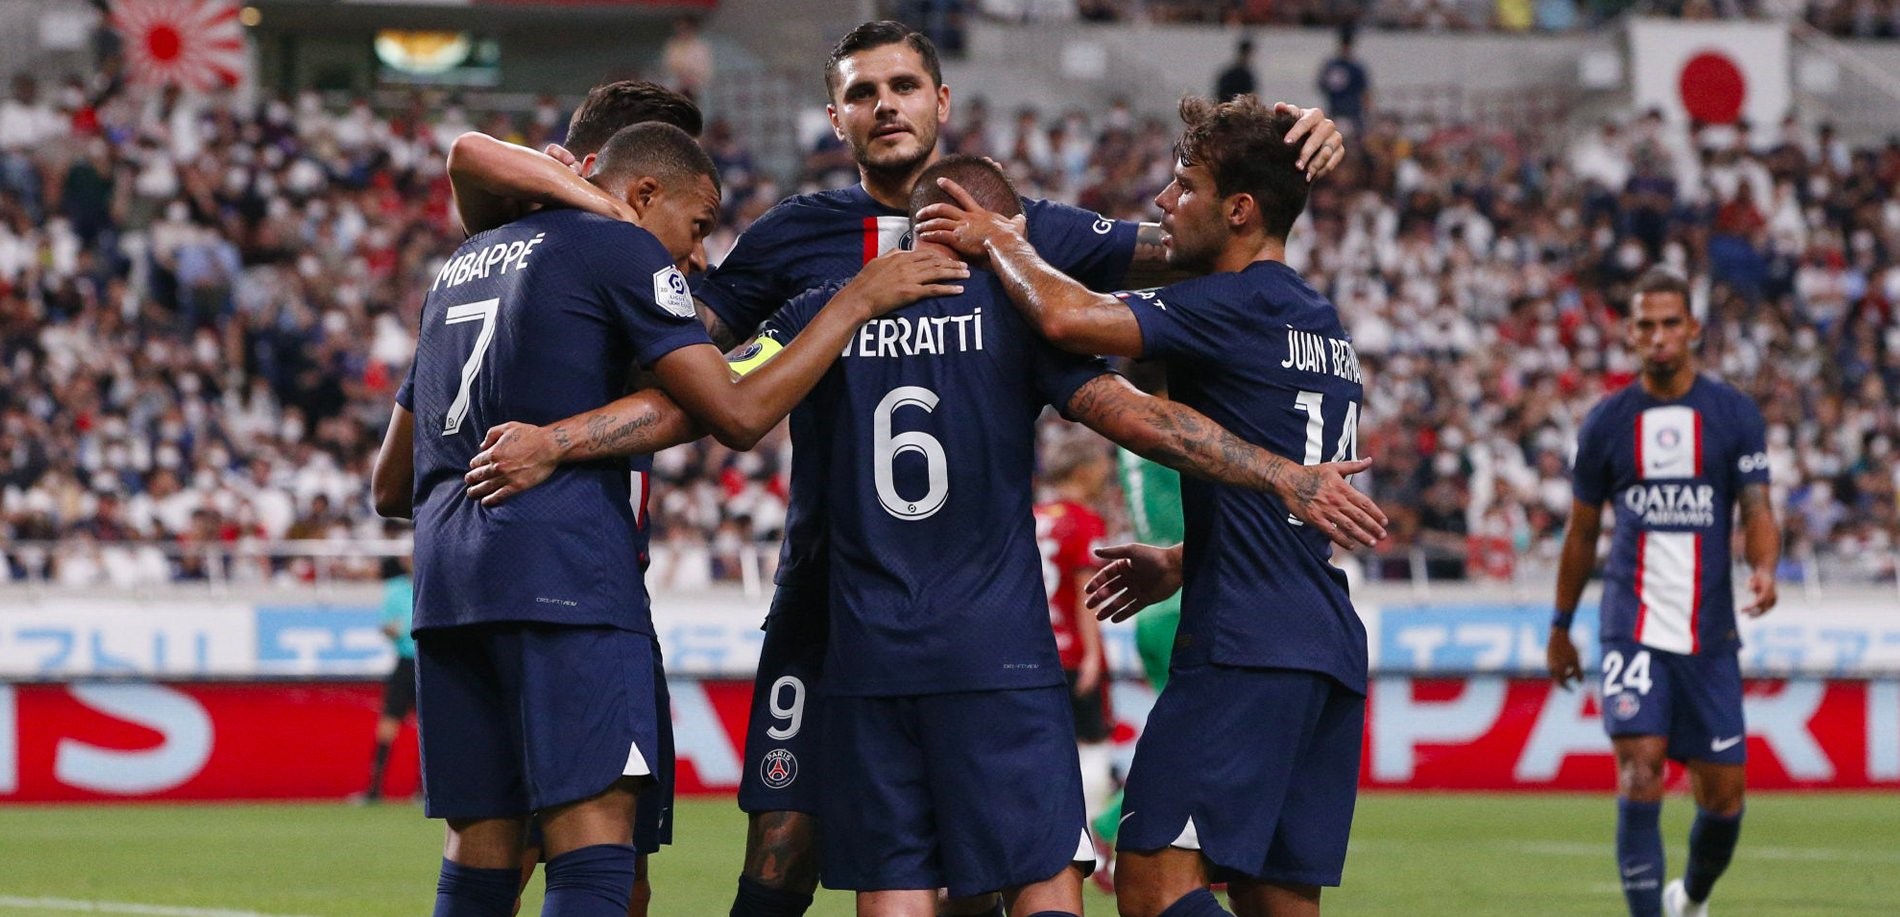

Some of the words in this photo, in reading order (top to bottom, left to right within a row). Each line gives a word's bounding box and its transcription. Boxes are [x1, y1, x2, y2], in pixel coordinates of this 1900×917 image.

[432, 232, 546, 292] MBAPPÉ
[442, 297, 500, 437] 7
[1281, 324, 1327, 374] JUAN
[874, 385, 949, 521] 6
[1289, 390, 1358, 526] 14
[1625, 484, 1714, 516] QATAR
[1603, 650, 1653, 697] 24
[766, 675, 806, 740] 9
[766, 751, 792, 761] PARIS
